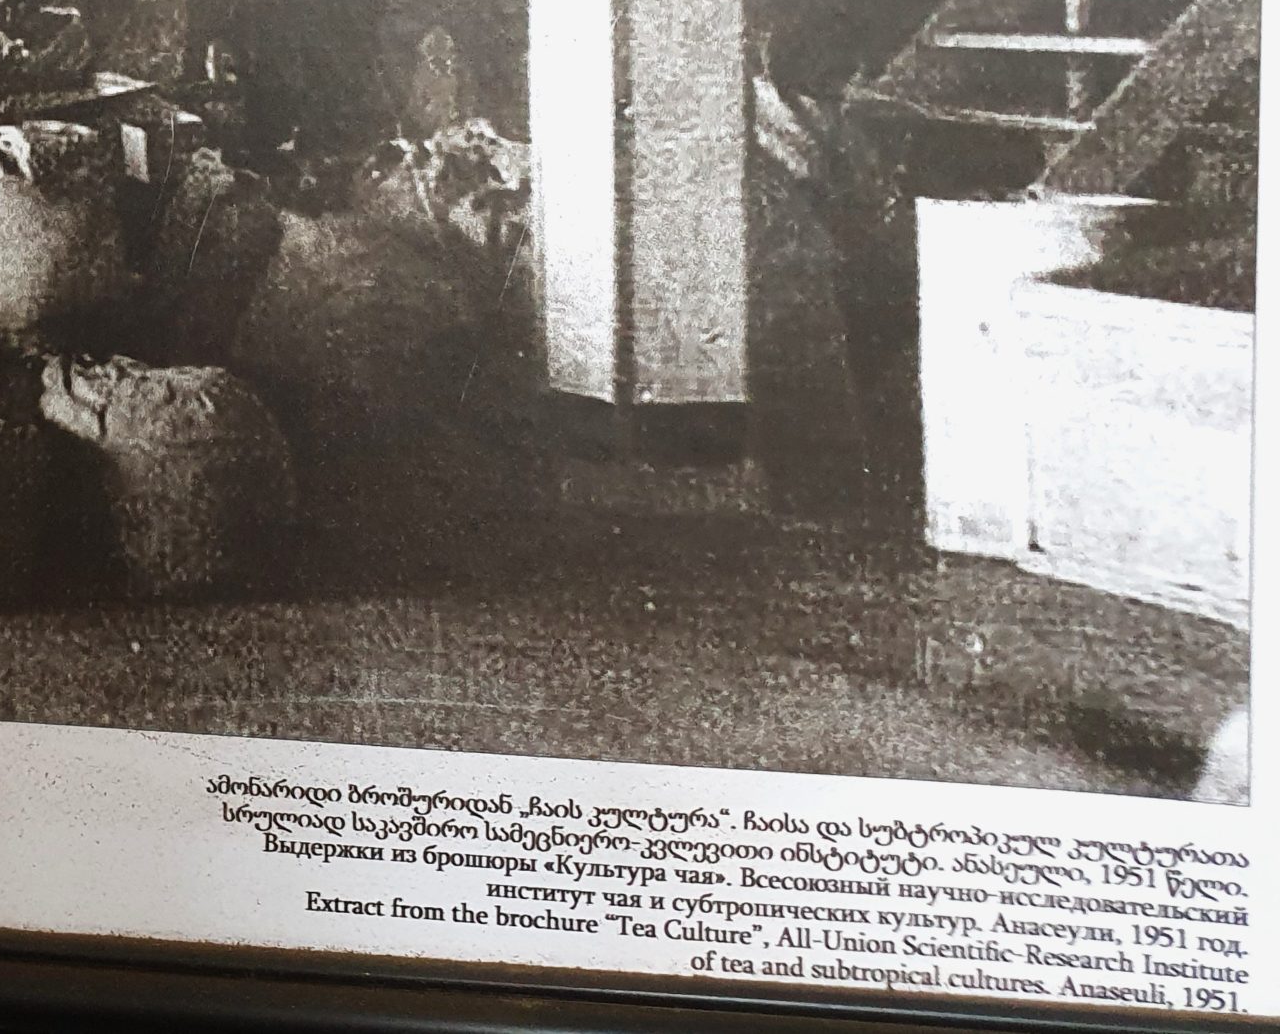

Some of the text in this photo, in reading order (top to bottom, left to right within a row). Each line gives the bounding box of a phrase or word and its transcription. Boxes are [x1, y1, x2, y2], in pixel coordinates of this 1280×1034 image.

[206, 774, 341, 808] ამონარიდი
[348, 784, 513, 820] ბროშურიდან
[743, 810, 810, 834] ჩაისა
[816, 820, 852, 843] და
[858, 817, 1062, 859] სუბტროპიკულ
[1067, 838, 1250, 868] კულტურათა
[222, 802, 345, 837] სრულიად
[352, 811, 478, 842] საკავშირო
[780, 842, 944, 877] ინსტიტუტი.
[952, 853, 1092, 887] ანასეული,
[1101, 864, 1156, 888] 1951
[1166, 869, 1249, 902] წელი.
[263, 833, 1250, 926] Выдержки из брошюры «Культура чая». Всесоюзный научно-исследовательский
[486, 883, 1249, 959] институт чая и субтропических культур. Анасеули, 1951 год.
[305, 890, 384, 916] Extract
[391, 898, 445, 921] from
[451, 902, 488, 925] the
[494, 905, 599, 933] brochure
[776, 927, 896, 954] All-Union
[903, 934, 1134, 973] Scientific-Research
[1142, 953, 1249, 984] Institute
[691, 950, 1249, 1013] of tea and subtropical cultures. Anaseuli, 1951.
